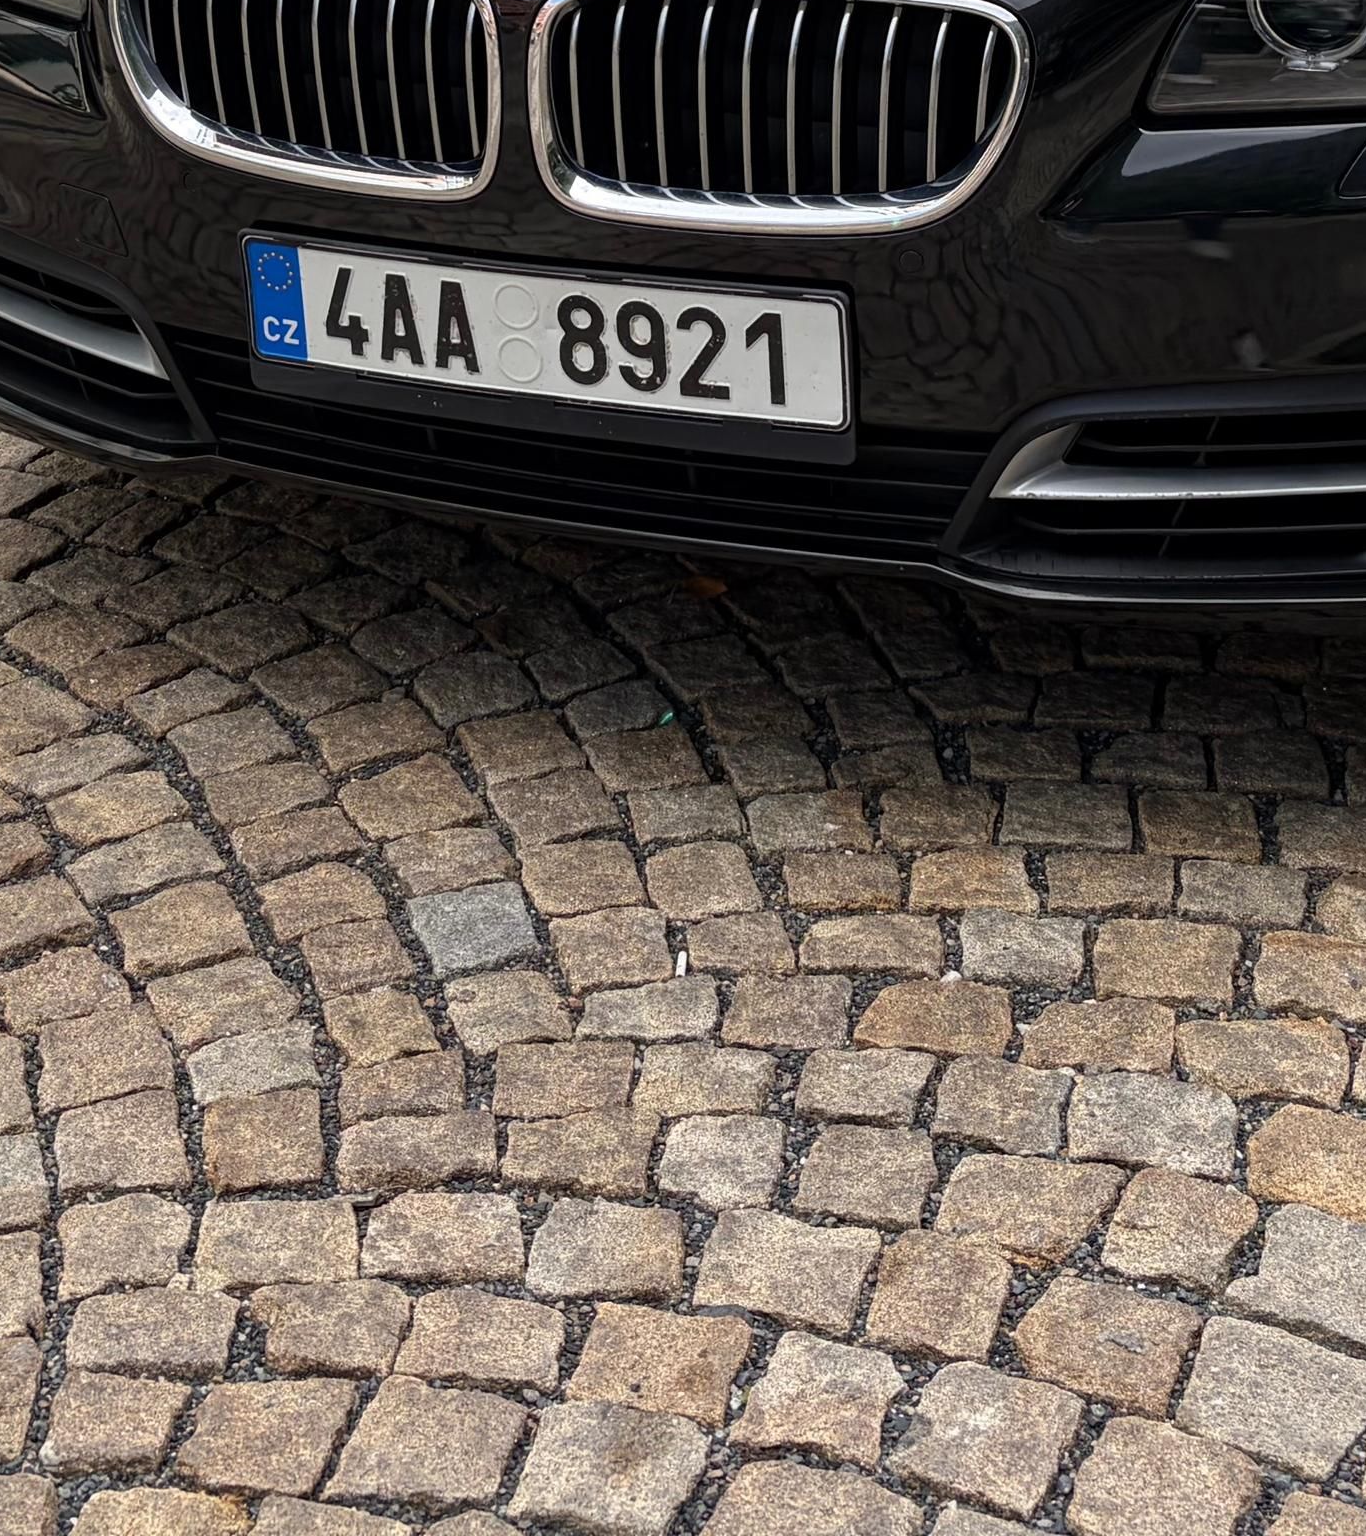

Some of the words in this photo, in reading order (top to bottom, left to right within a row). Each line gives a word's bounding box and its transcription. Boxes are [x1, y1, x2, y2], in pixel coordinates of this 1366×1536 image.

[263, 315, 300, 345] CZ
[324, 267, 482, 373] 4AA
[557, 293, 787, 406] 8921
